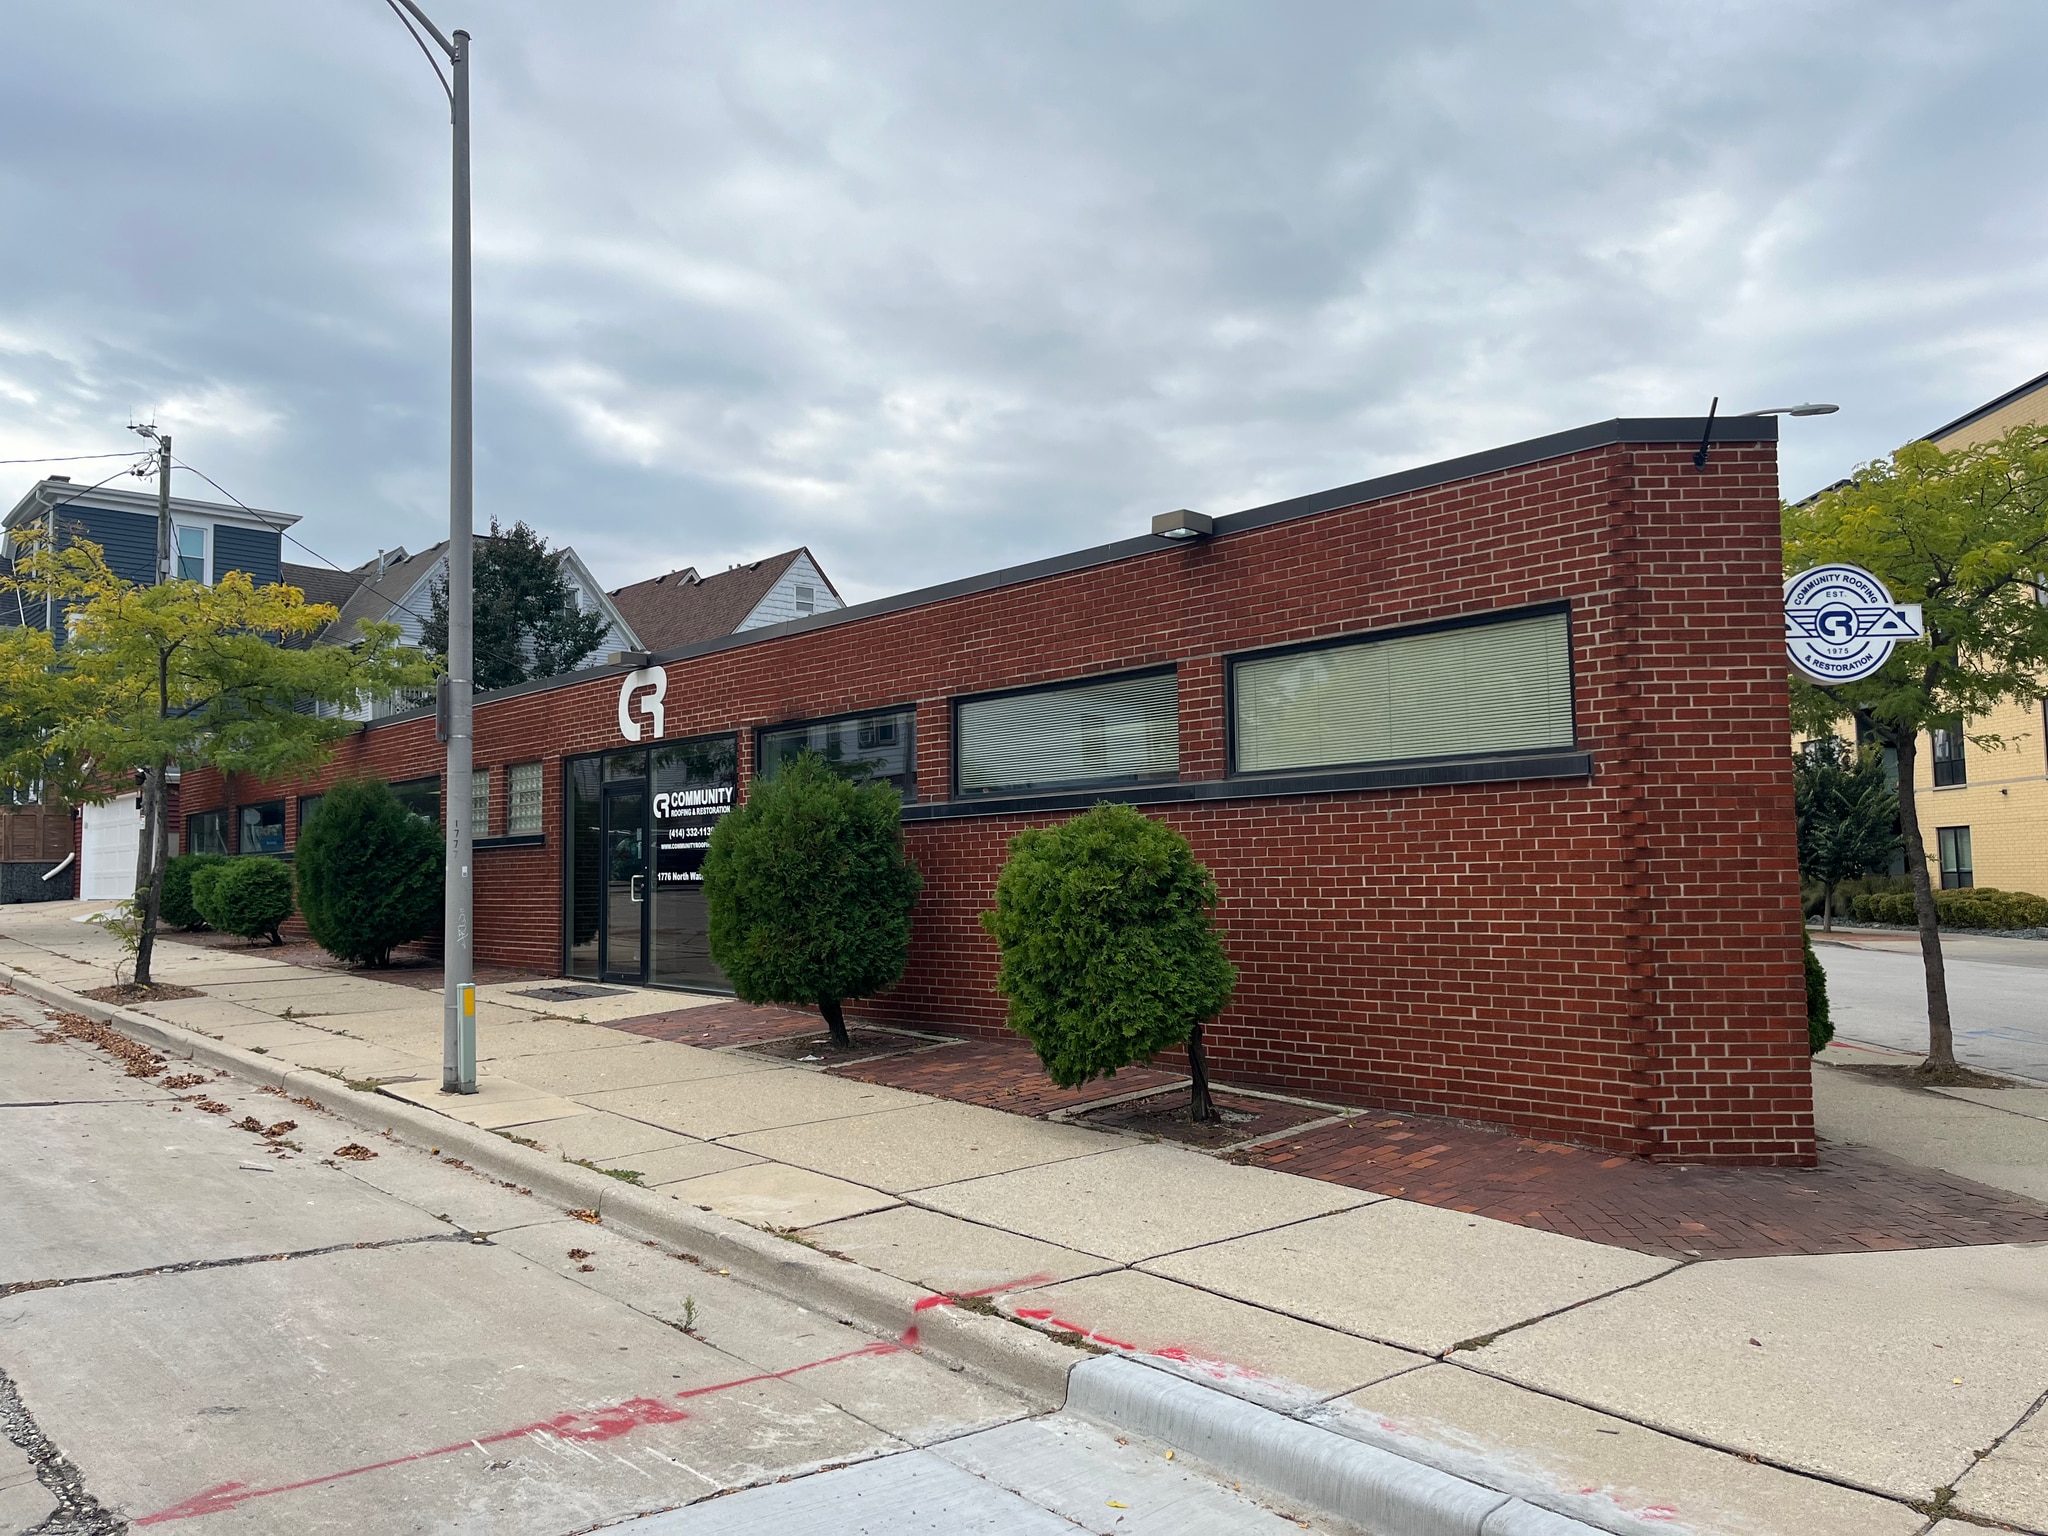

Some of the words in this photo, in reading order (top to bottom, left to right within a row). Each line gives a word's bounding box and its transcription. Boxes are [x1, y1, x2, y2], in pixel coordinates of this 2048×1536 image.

[1794, 574, 1840, 606] COMMUNITY
[1842, 575, 1878, 604] ROOFING
[1812, 653, 1874, 672] RESTORATION
[671, 787, 733, 807] COMMUNITY
[671, 808, 691, 817] ROOFING
[692, 808, 696, 816] &
[696, 805, 731, 815] RESTORATION
[669, 828, 685, 840] (414)
[657, 872, 671, 881] 1776
[672, 871, 689, 881] North
